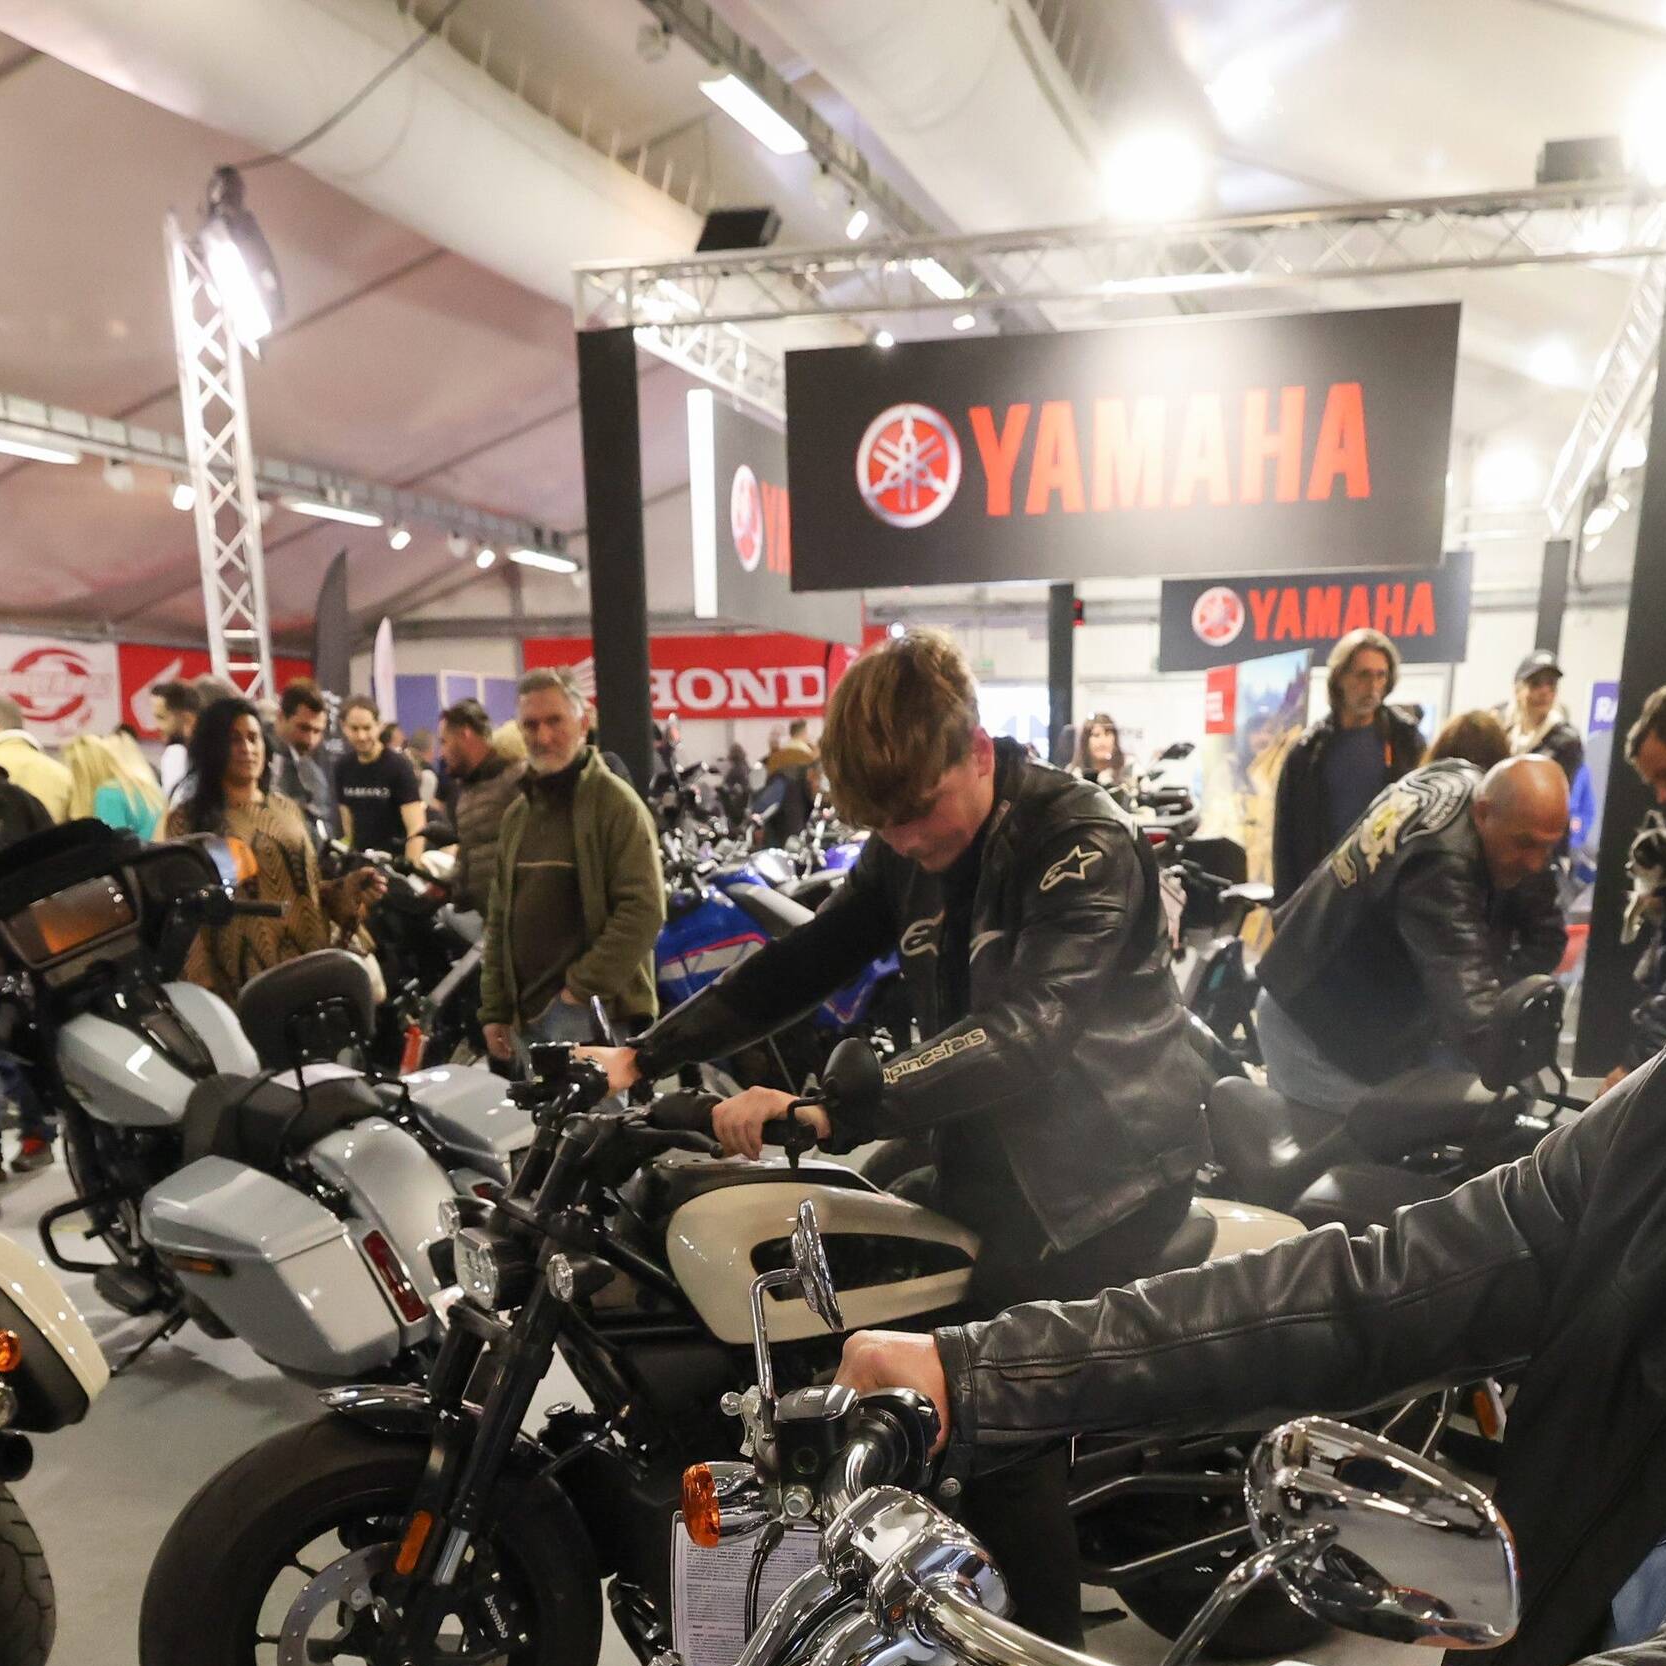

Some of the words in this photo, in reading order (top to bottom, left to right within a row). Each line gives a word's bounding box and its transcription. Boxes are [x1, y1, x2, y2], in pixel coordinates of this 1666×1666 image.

[969, 382, 1371, 517] YAMAHA
[1247, 581, 1436, 641] YAMAHA
[485, 1594, 508, 1638] brembo
